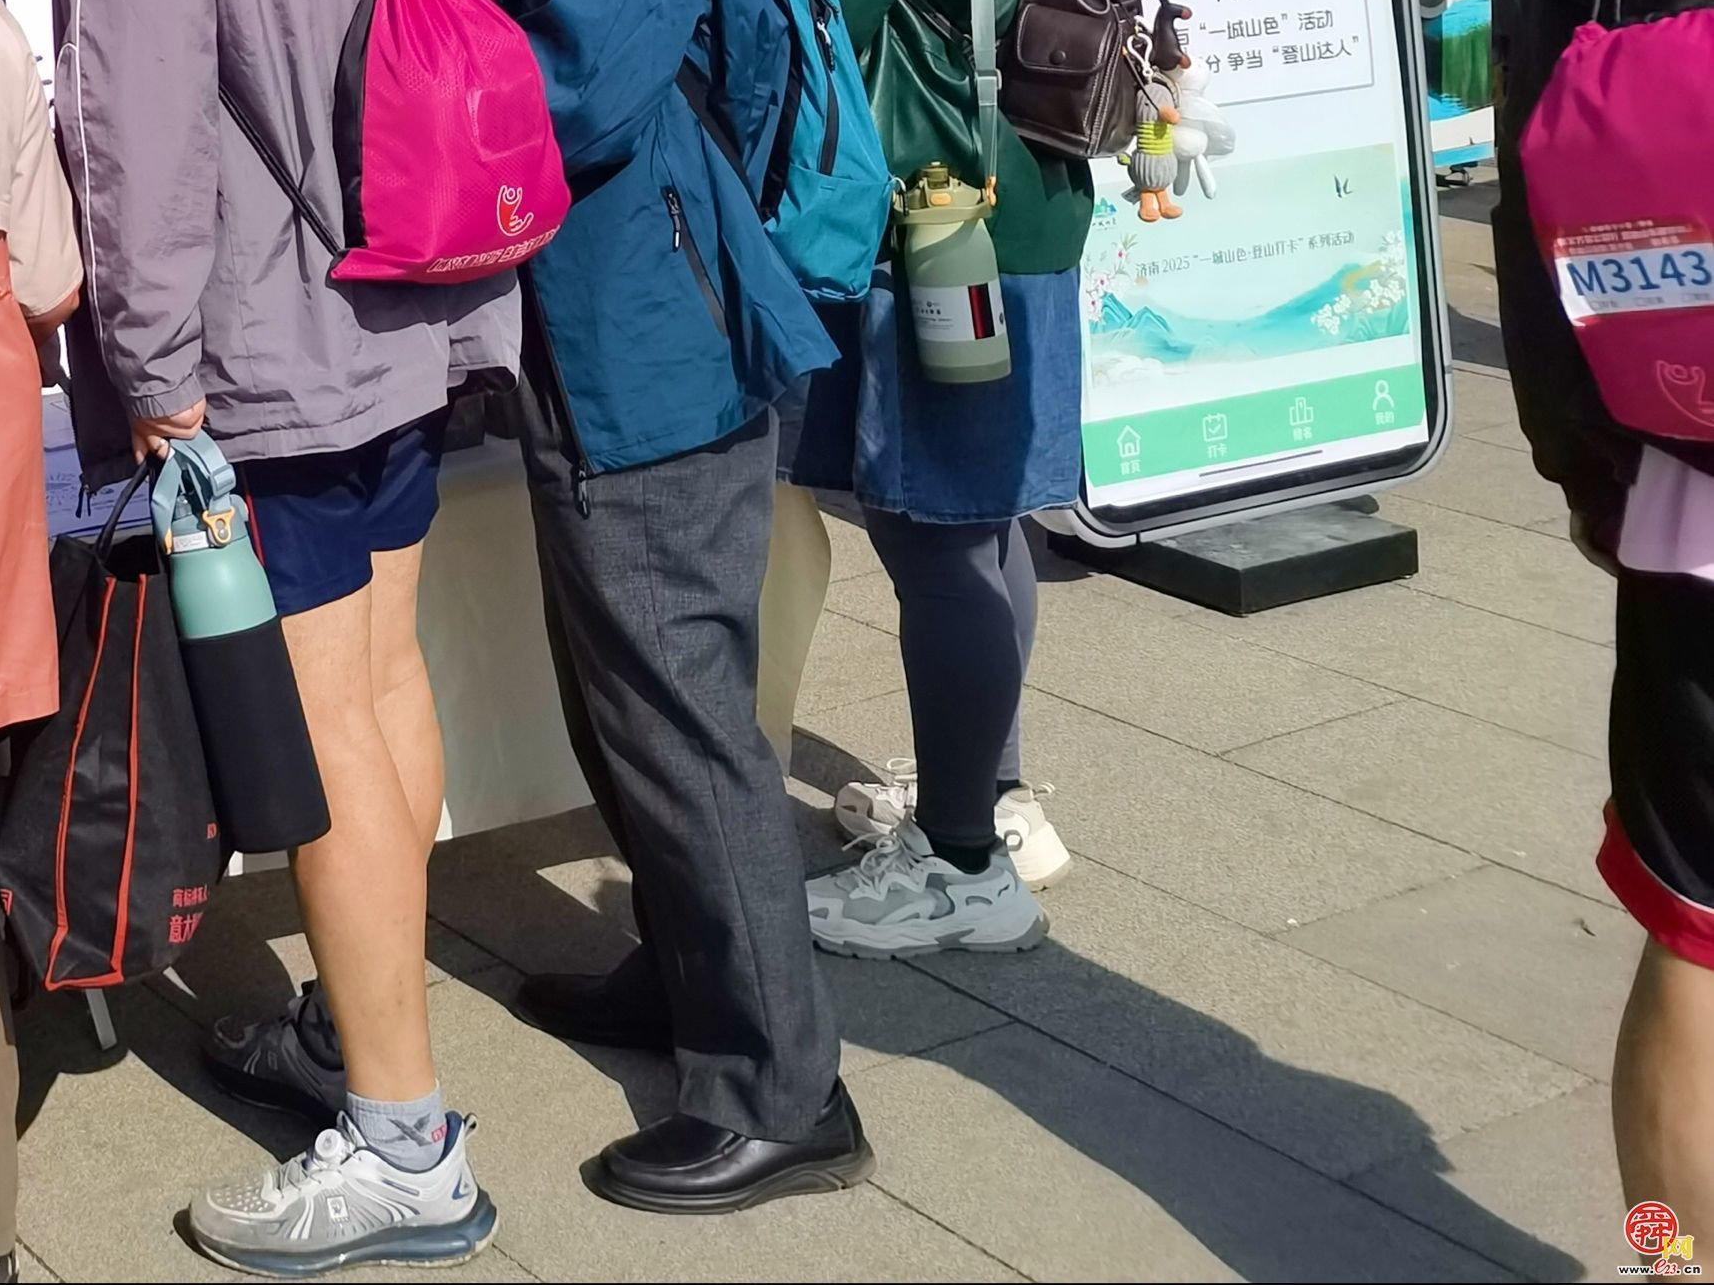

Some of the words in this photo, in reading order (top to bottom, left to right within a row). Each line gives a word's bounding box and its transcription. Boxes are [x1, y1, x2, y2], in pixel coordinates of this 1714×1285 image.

[1566, 251, 1713, 296] M3143
[1374, 411, 1395, 425] 我的
[1206, 445, 1227, 459] 打卡
[1120, 459, 1142, 475] 首页
